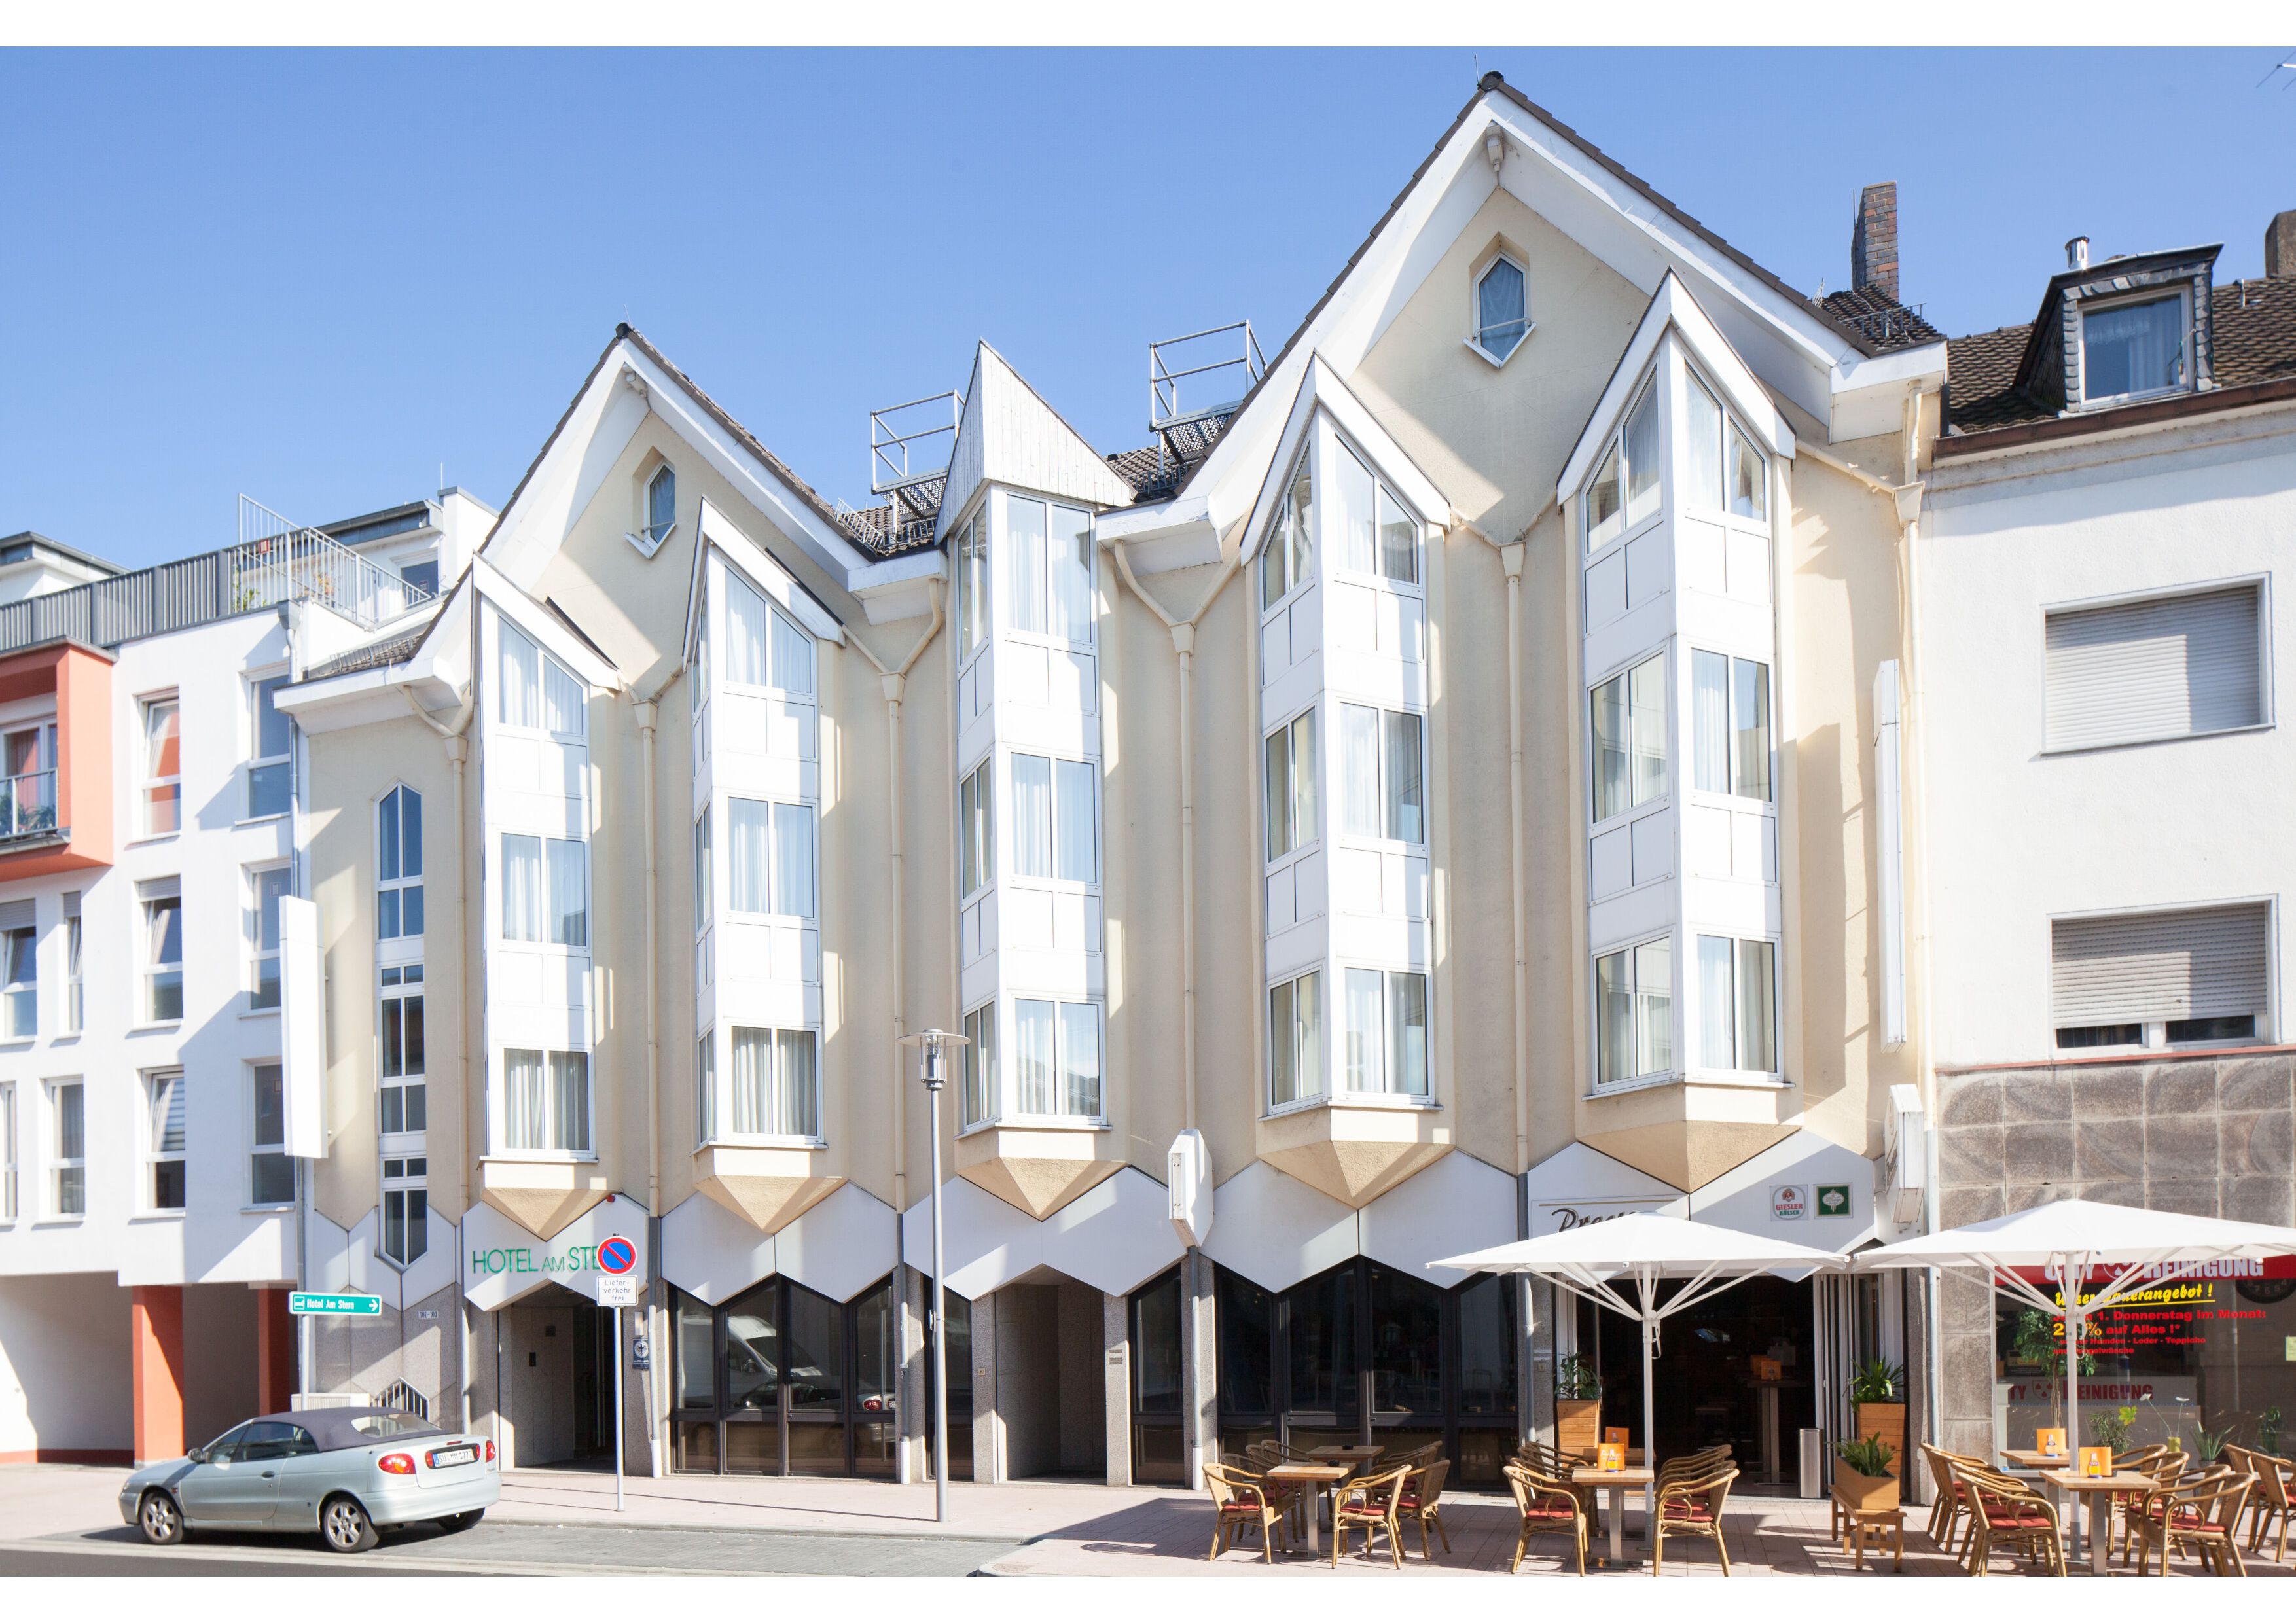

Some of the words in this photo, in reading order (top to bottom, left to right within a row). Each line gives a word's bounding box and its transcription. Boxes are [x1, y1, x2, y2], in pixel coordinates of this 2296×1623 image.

[473, 1248, 539, 1274] HOTEL
[542, 1256, 565, 1272] AM
[568, 1245, 599, 1271] STE
[306, 1298, 324, 1309] Hotel
[325, 1299, 336, 1309] Am
[338, 1300, 355, 1310] Stern
[2096, 1311, 2109, 1321] 1.
[2113, 1310, 2193, 1322] Donnerstag
[2197, 1310, 2214, 1319] im
[2217, 1309, 2266, 1319] Monat:
[2106, 1325, 2128, 1334] auf
[2131, 1325, 2166, 1334] Alles
[2063, 1380, 2153, 1400] EINIGUNG
